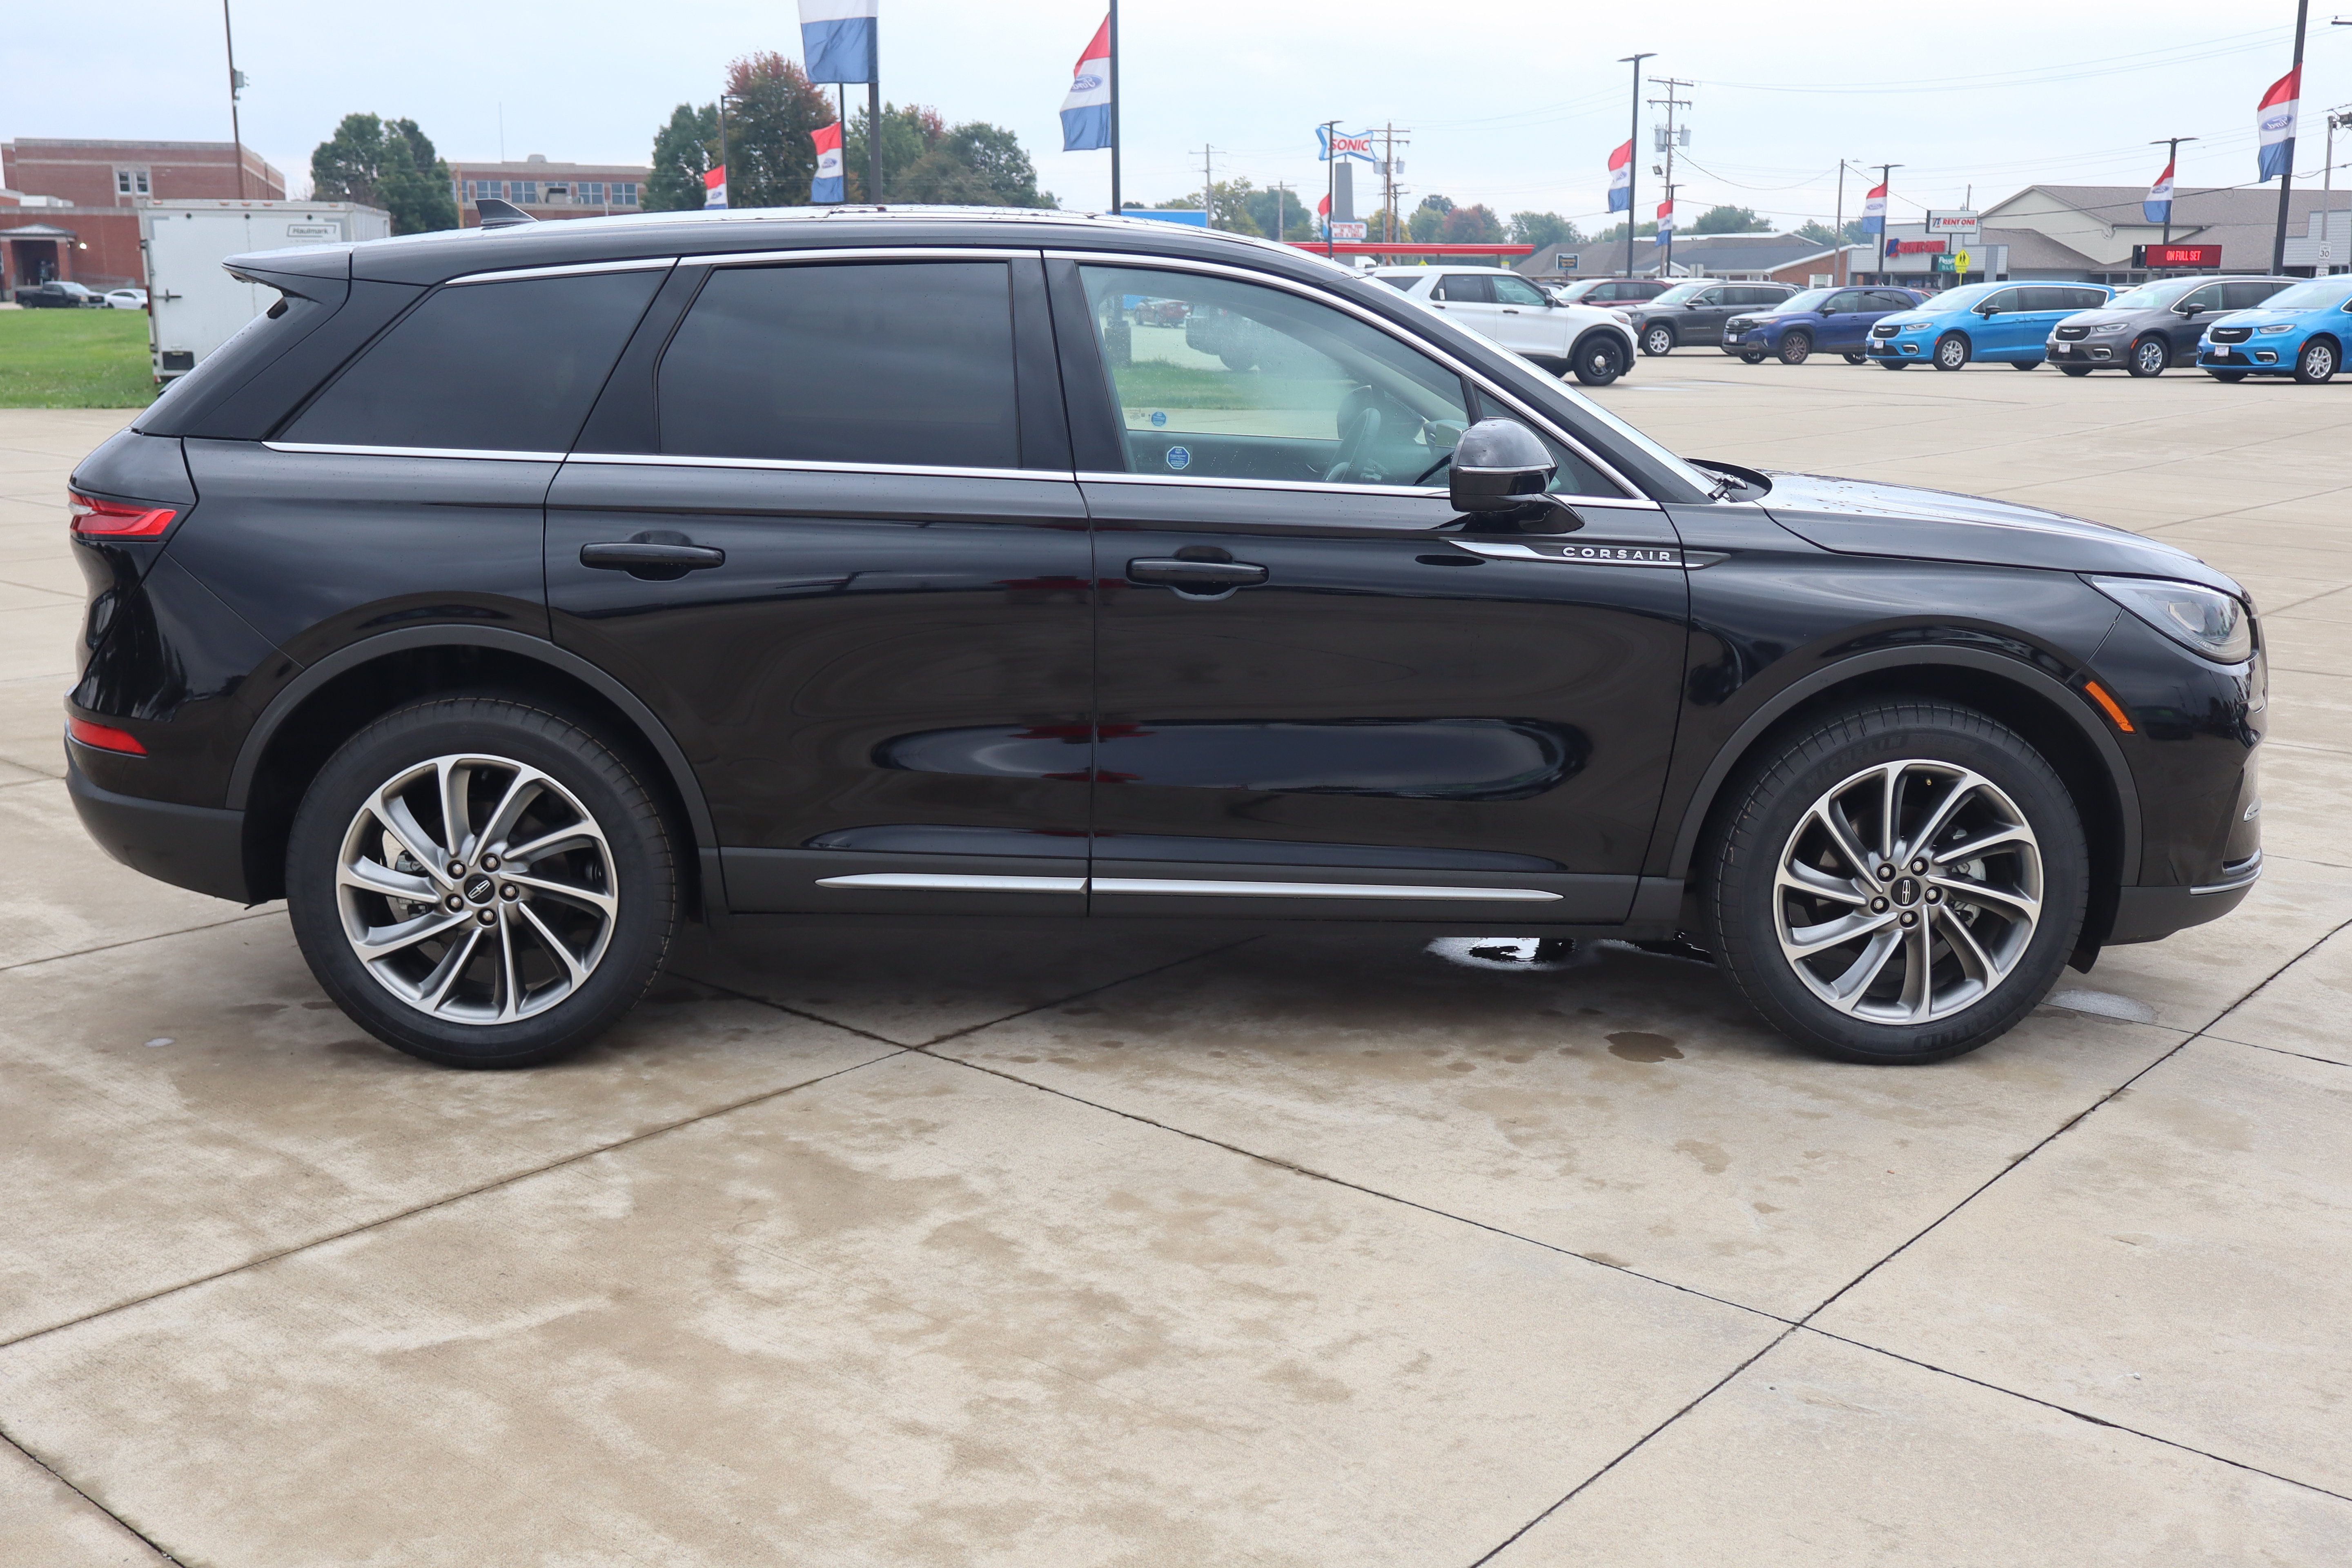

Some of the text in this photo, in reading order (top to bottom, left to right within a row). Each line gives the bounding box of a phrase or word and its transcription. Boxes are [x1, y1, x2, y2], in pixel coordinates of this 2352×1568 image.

[1328, 138, 1370, 151] SONIC
[2166, 250, 2201, 261] ON FULL SET
[1563, 547, 1670, 561] CORSAIR
[1805, 736, 1903, 790] MICHELIN
